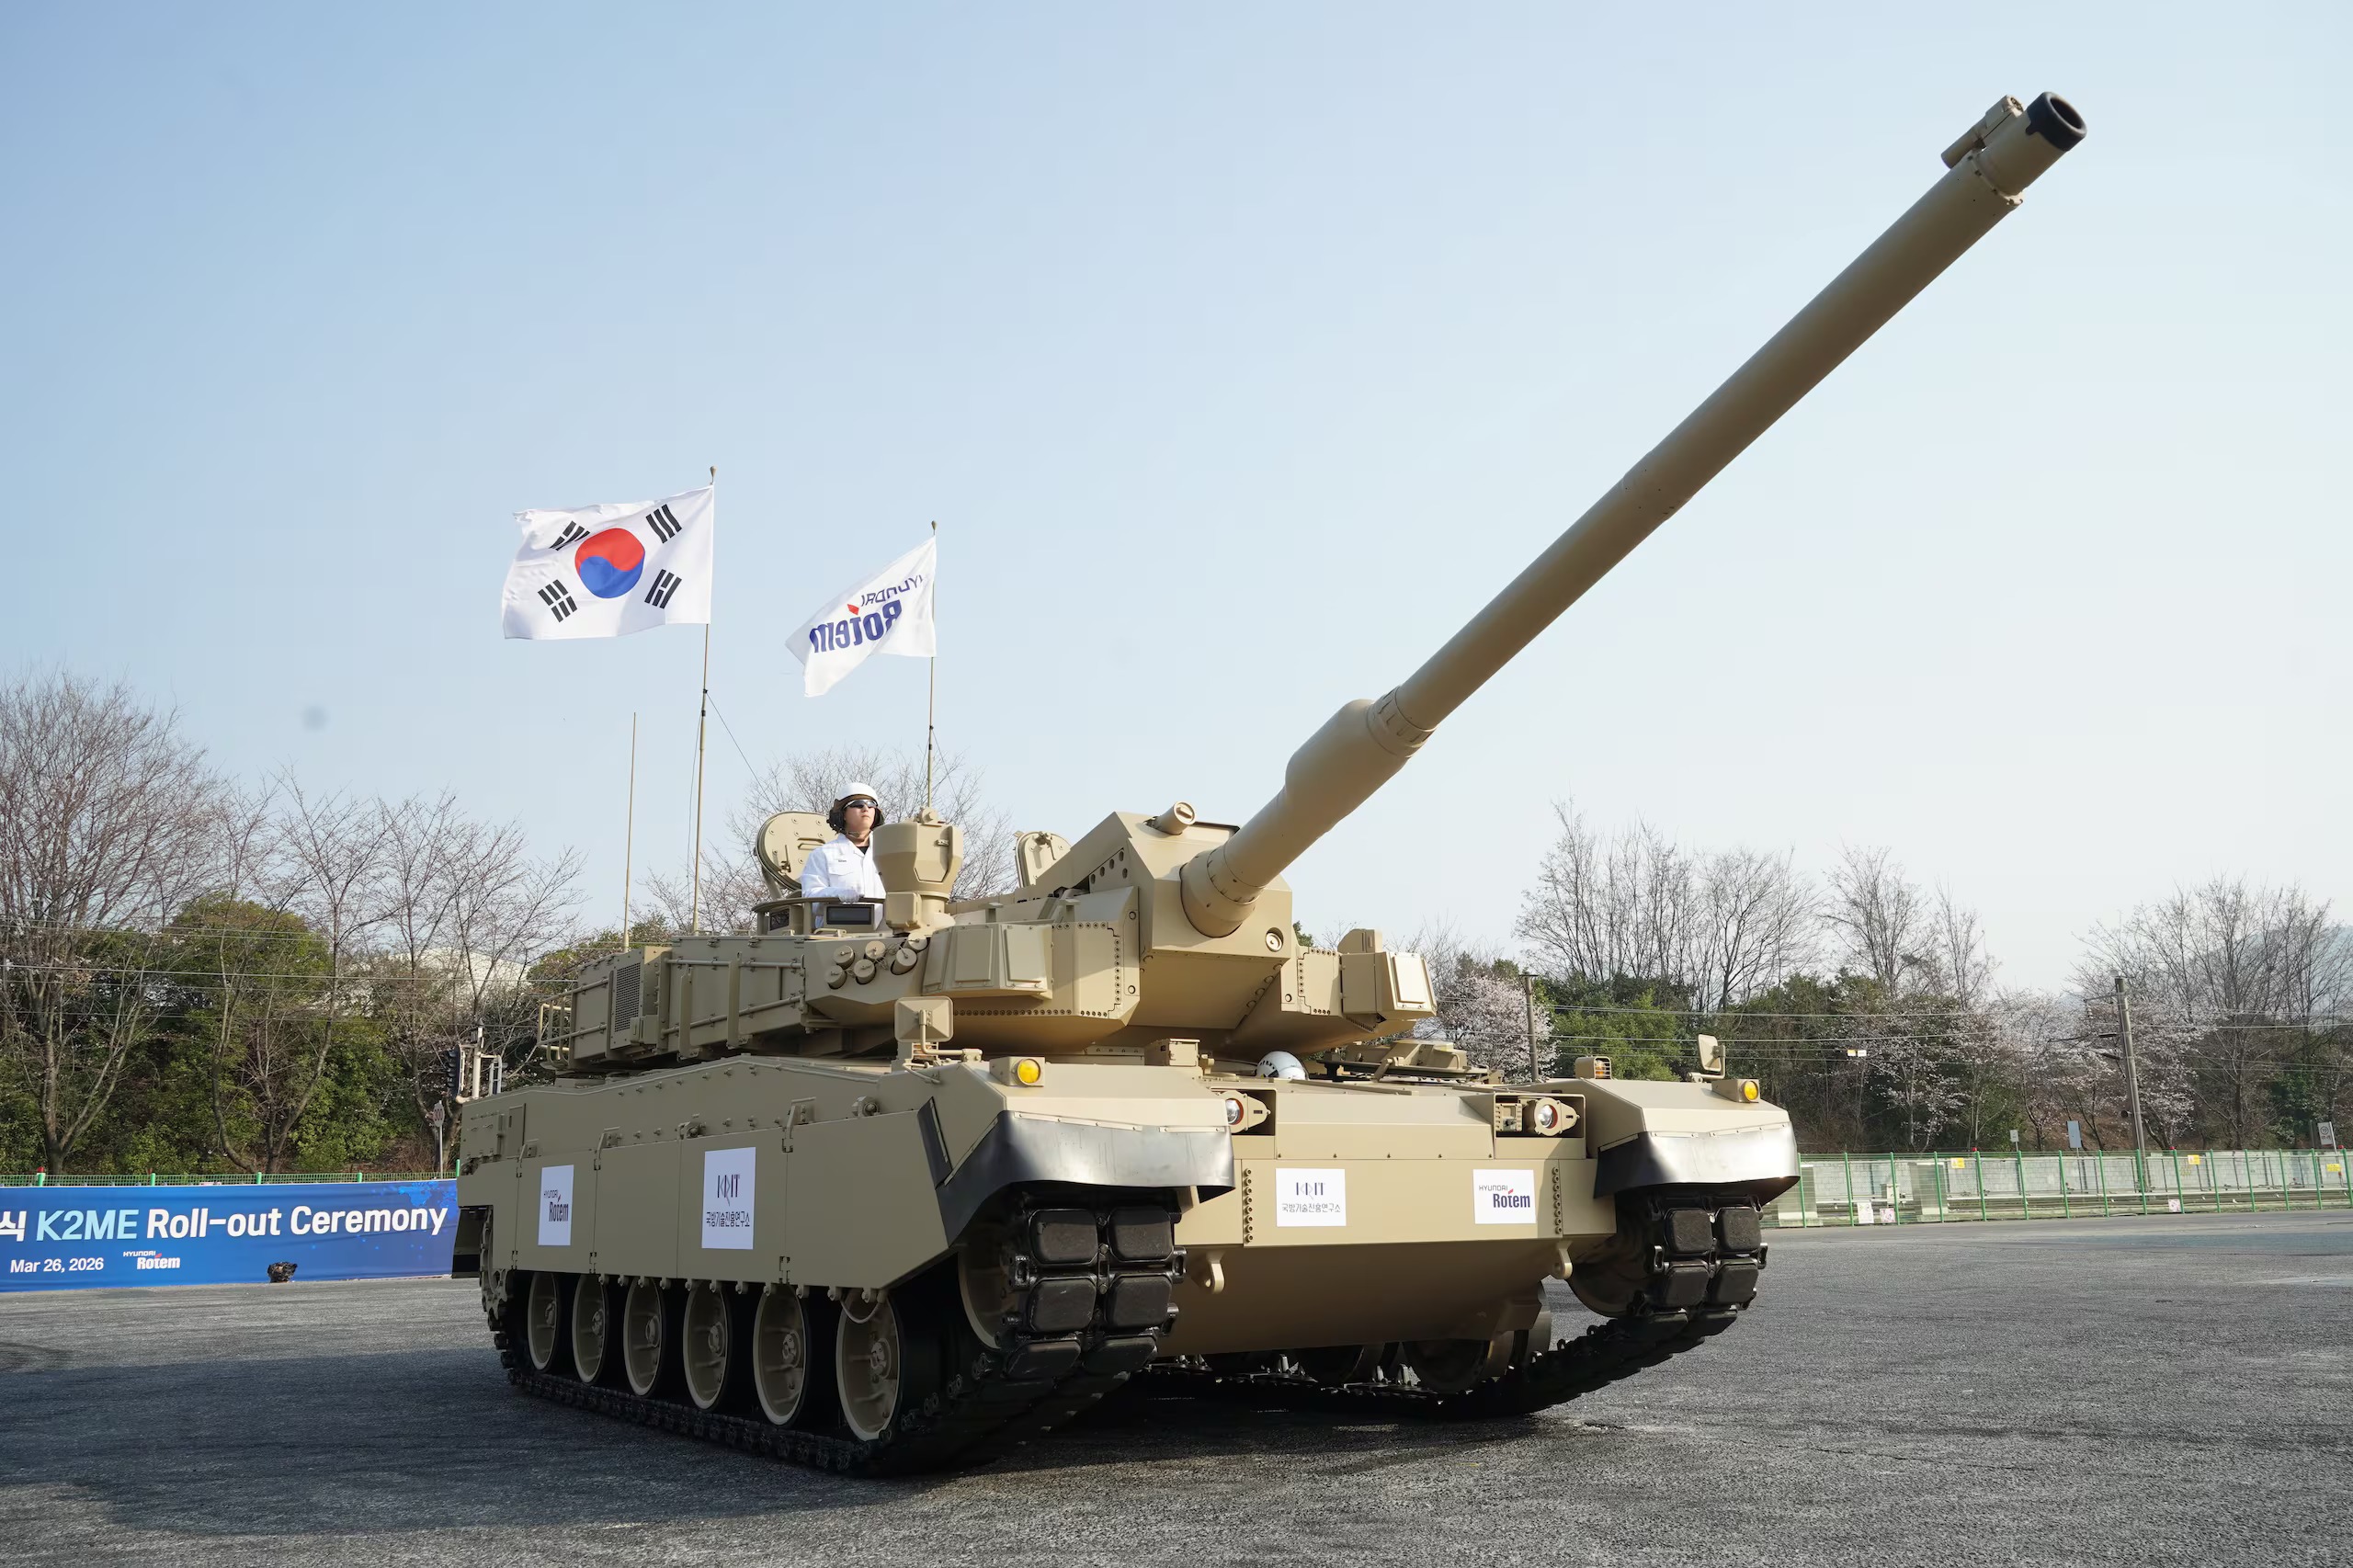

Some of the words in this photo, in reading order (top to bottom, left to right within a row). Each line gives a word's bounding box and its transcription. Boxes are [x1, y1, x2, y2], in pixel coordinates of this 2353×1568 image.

[1281, 1202, 1341, 1213] 국방기술진흥연구소
[1493, 1193, 1530, 1209] Rotem
[549, 1201, 569, 1222] Rotem
[706, 1211, 750, 1227] 국방기술진흥연구소
[36, 1210, 139, 1241] K2ME
[146, 1208, 281, 1239] Roll-out
[290, 1205, 448, 1235] Ceremony
[10, 1259, 40, 1274] Mar
[43, 1258, 65, 1274] 26,
[69, 1257, 104, 1272] 2026
[136, 1256, 180, 1270] Rotem
